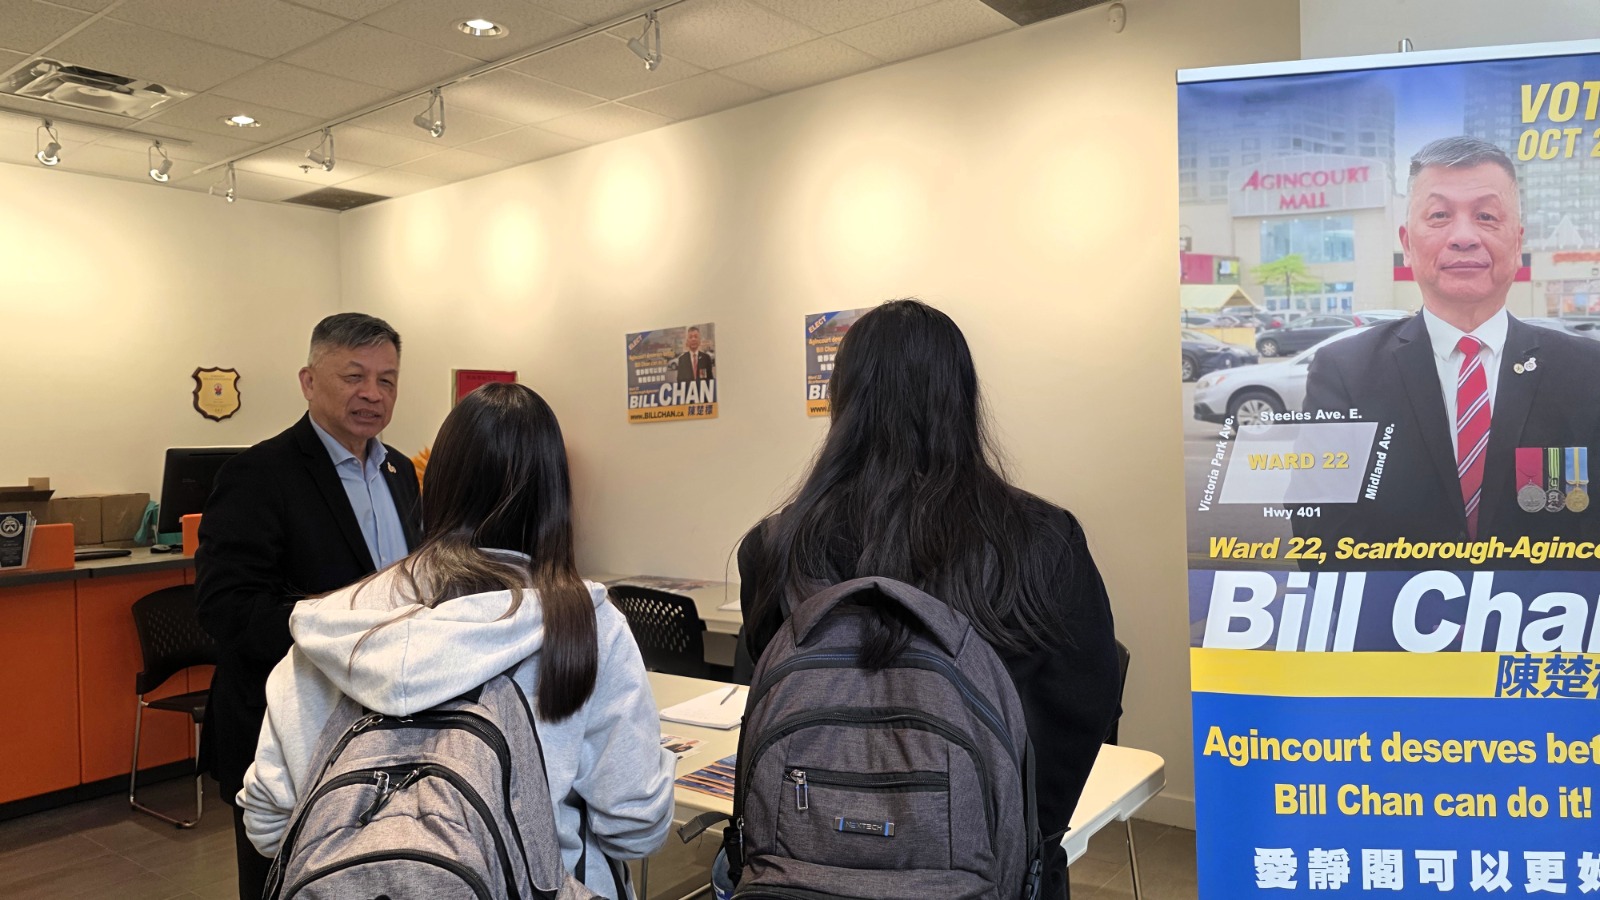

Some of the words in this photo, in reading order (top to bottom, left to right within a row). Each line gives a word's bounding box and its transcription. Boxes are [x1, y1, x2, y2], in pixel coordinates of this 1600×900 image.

[1521, 81, 1600, 124] VOT
[1517, 128, 1582, 161] OCT
[1590, 128, 1600, 158] 2
[1241, 166, 1370, 191] AGINCOURT
[1279, 192, 1330, 210] MALL
[808, 315, 827, 334] ELECT
[630, 394, 658, 409] BILL
[659, 379, 714, 406] CHAN
[808, 384, 829, 400] BI
[1219, 415, 1235, 439] Ave.
[1260, 410, 1311, 421] Steeles
[1315, 409, 1345, 420] Ave.
[1349, 408, 1362, 419] E.
[1211, 440, 1228, 467] Park
[1247, 452, 1315, 470] WARD
[1322, 451, 1350, 469] 22
[1365, 451, 1387, 500] Midland
[1378, 423, 1395, 450] Ave.
[1198, 469, 1220, 512] Victoria
[1263, 507, 1293, 520] Hwy
[1297, 506, 1321, 518] 401
[1208, 537, 1281, 560] Ward
[1284, 537, 1327, 565] 22,
[1334, 536, 1600, 565] Scarborough-Aginc
[1202, 570, 1367, 652] Bill
[1391, 569, 1600, 654] Cha
[1494, 653, 1600, 699] 陳楚
[1203, 725, 1371, 767] Agincourt
[1381, 731, 1537, 764] deserves
[1546, 732, 1600, 765] bet
[1274, 783, 1327, 816] Bill
[1337, 783, 1424, 817] Chan
[1433, 791, 1497, 818] can
[1506, 786, 1549, 818] do
[1558, 786, 1592, 819] it!
[846, 821, 882, 831] NEXTECH
